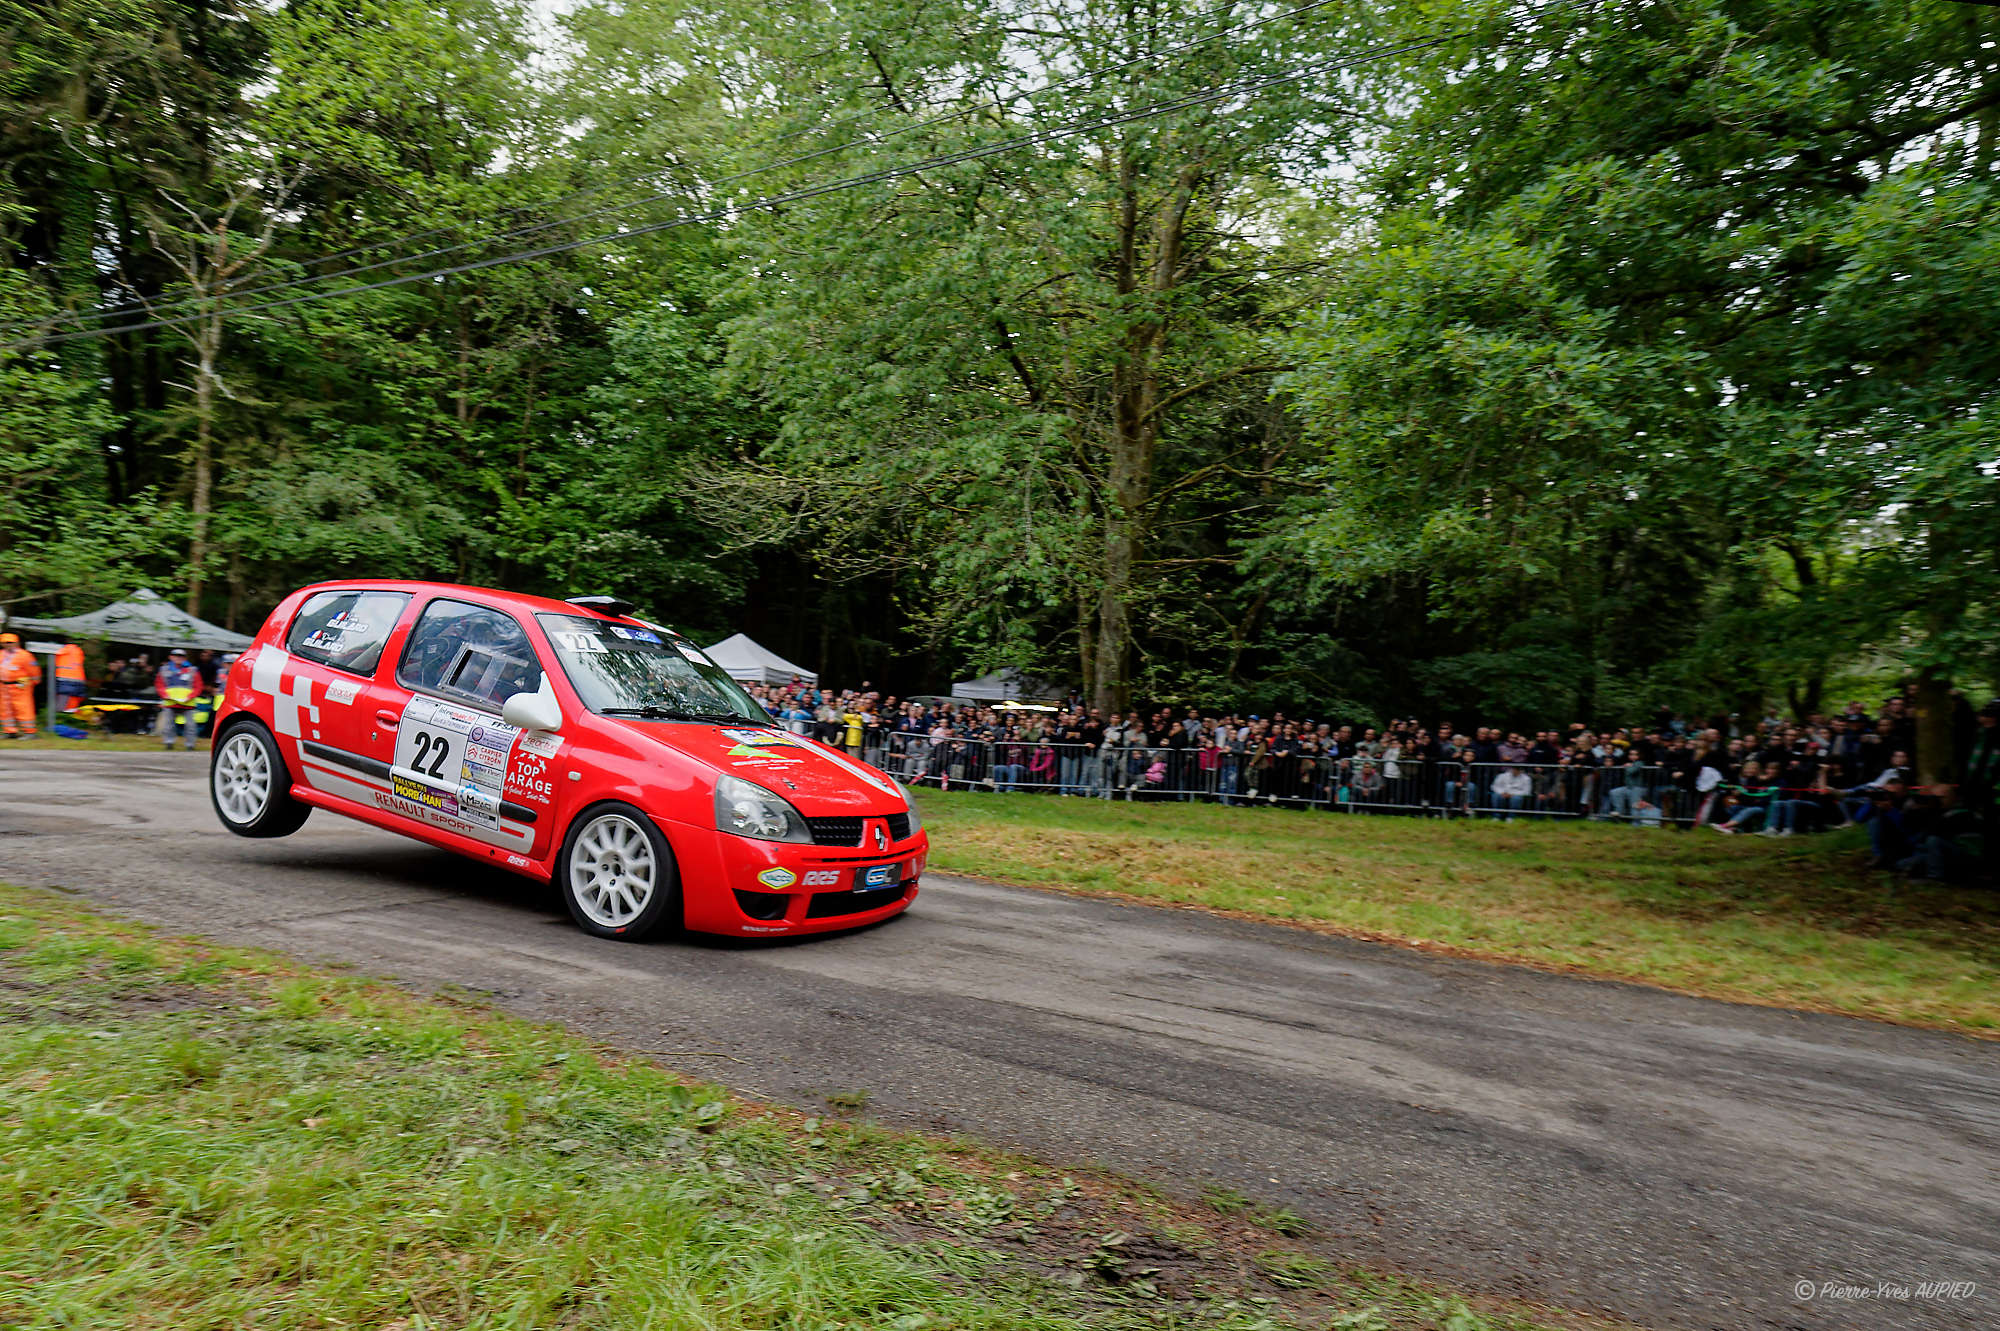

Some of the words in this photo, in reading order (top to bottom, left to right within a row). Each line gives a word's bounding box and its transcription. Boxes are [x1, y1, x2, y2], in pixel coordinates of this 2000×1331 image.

[565, 634, 598, 651] 22
[410, 731, 450, 780] 22
[517, 761, 540, 777] TOP
[507, 772, 553, 795] ARAGE
[374, 791, 426, 819] RENAULT
[430, 813, 476, 833] SPORT
[801, 870, 841, 886] RRS
